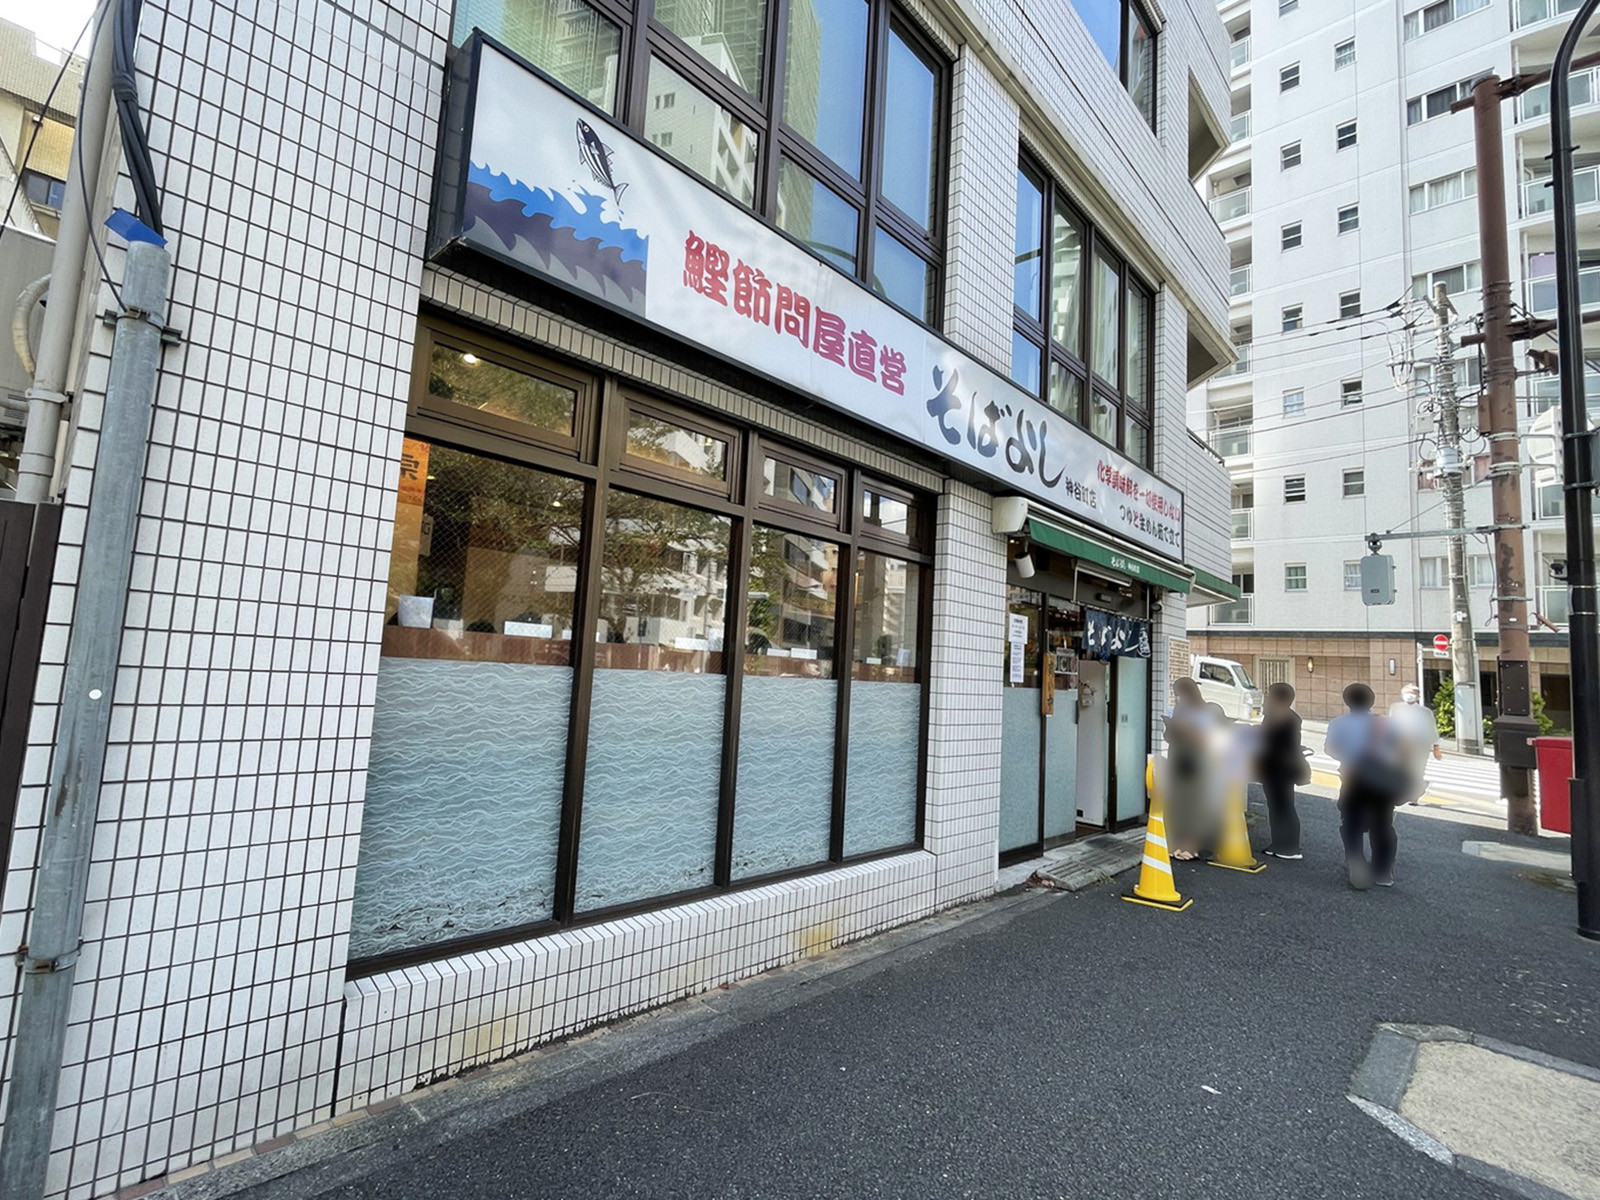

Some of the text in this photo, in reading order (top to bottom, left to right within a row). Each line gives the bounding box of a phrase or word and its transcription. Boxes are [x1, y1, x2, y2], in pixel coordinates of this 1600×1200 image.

[683, 229, 907, 396] 鰹節問屋直営
[926, 364, 1066, 488] そばよし
[1065, 476, 1097, 509] 神谷町店
